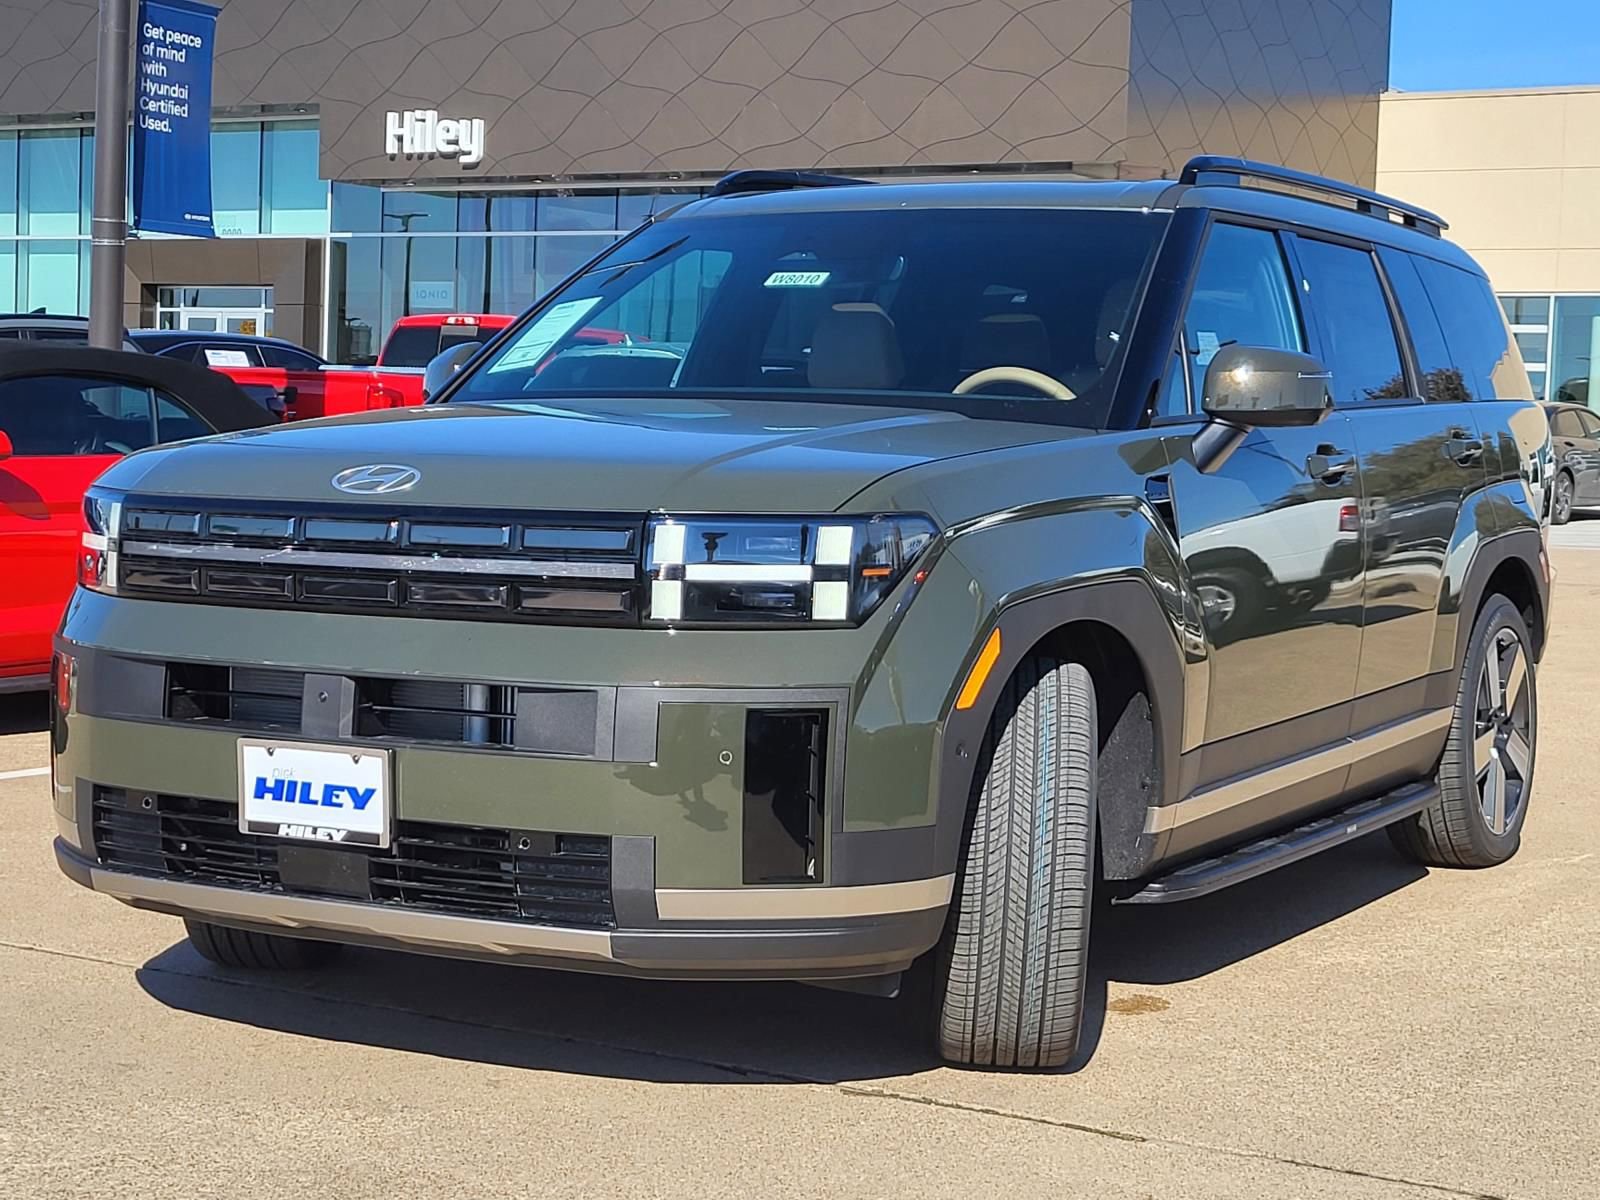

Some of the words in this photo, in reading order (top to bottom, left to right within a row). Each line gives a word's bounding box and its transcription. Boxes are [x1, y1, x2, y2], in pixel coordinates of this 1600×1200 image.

[143, 22, 164, 40] Get
[166, 29, 202, 48] peace
[142, 42, 155, 56] of
[156, 46, 186, 63] mind
[141, 60, 167, 77] with
[141, 78, 188, 100] Hyundai
[140, 96, 188, 118] Certified
[139, 114, 172, 133] Used.
[386, 109, 485, 164] Hiley
[772, 274, 821, 284] W8010
[253, 776, 377, 811] HILEY
[277, 823, 349, 842] HILEY
